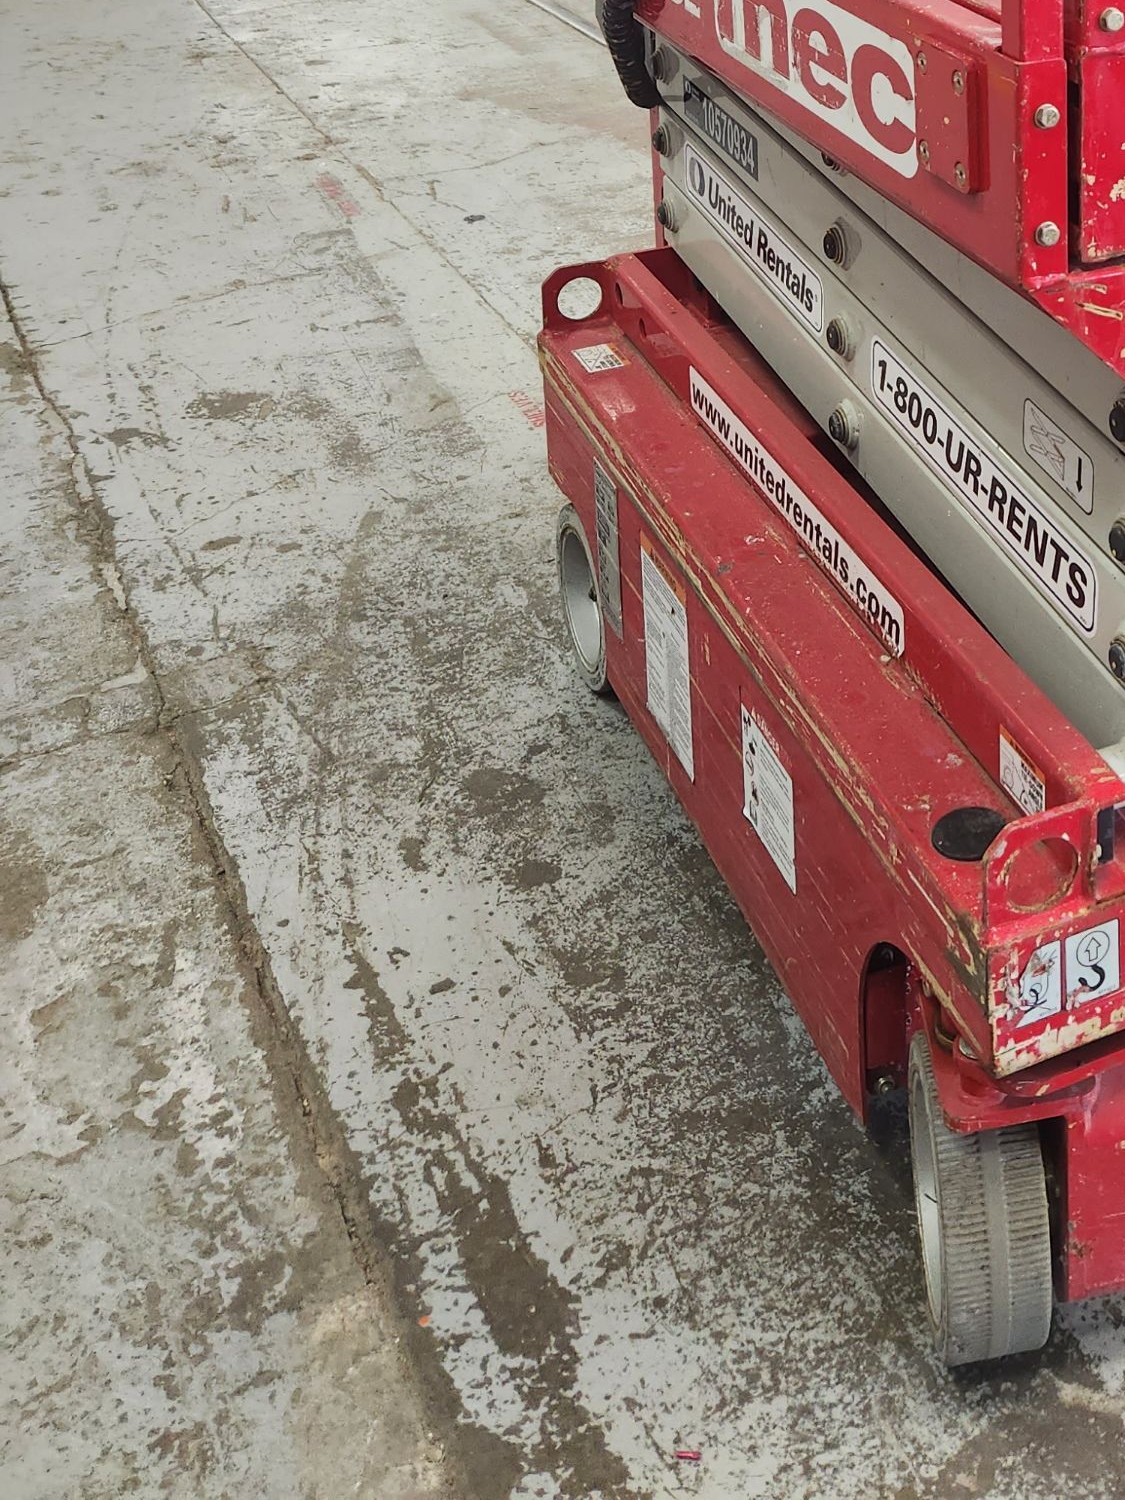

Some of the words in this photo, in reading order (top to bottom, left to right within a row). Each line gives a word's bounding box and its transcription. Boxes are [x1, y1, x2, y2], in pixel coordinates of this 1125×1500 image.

[702, 97, 756, 175] 10570934
[708, 177, 754, 249] United
[757, 227, 814, 314] Rentals
[691, 382, 901, 648] www.unitedrentals.com
[878, 359, 1088, 610] 1-800-UR-RENTS
